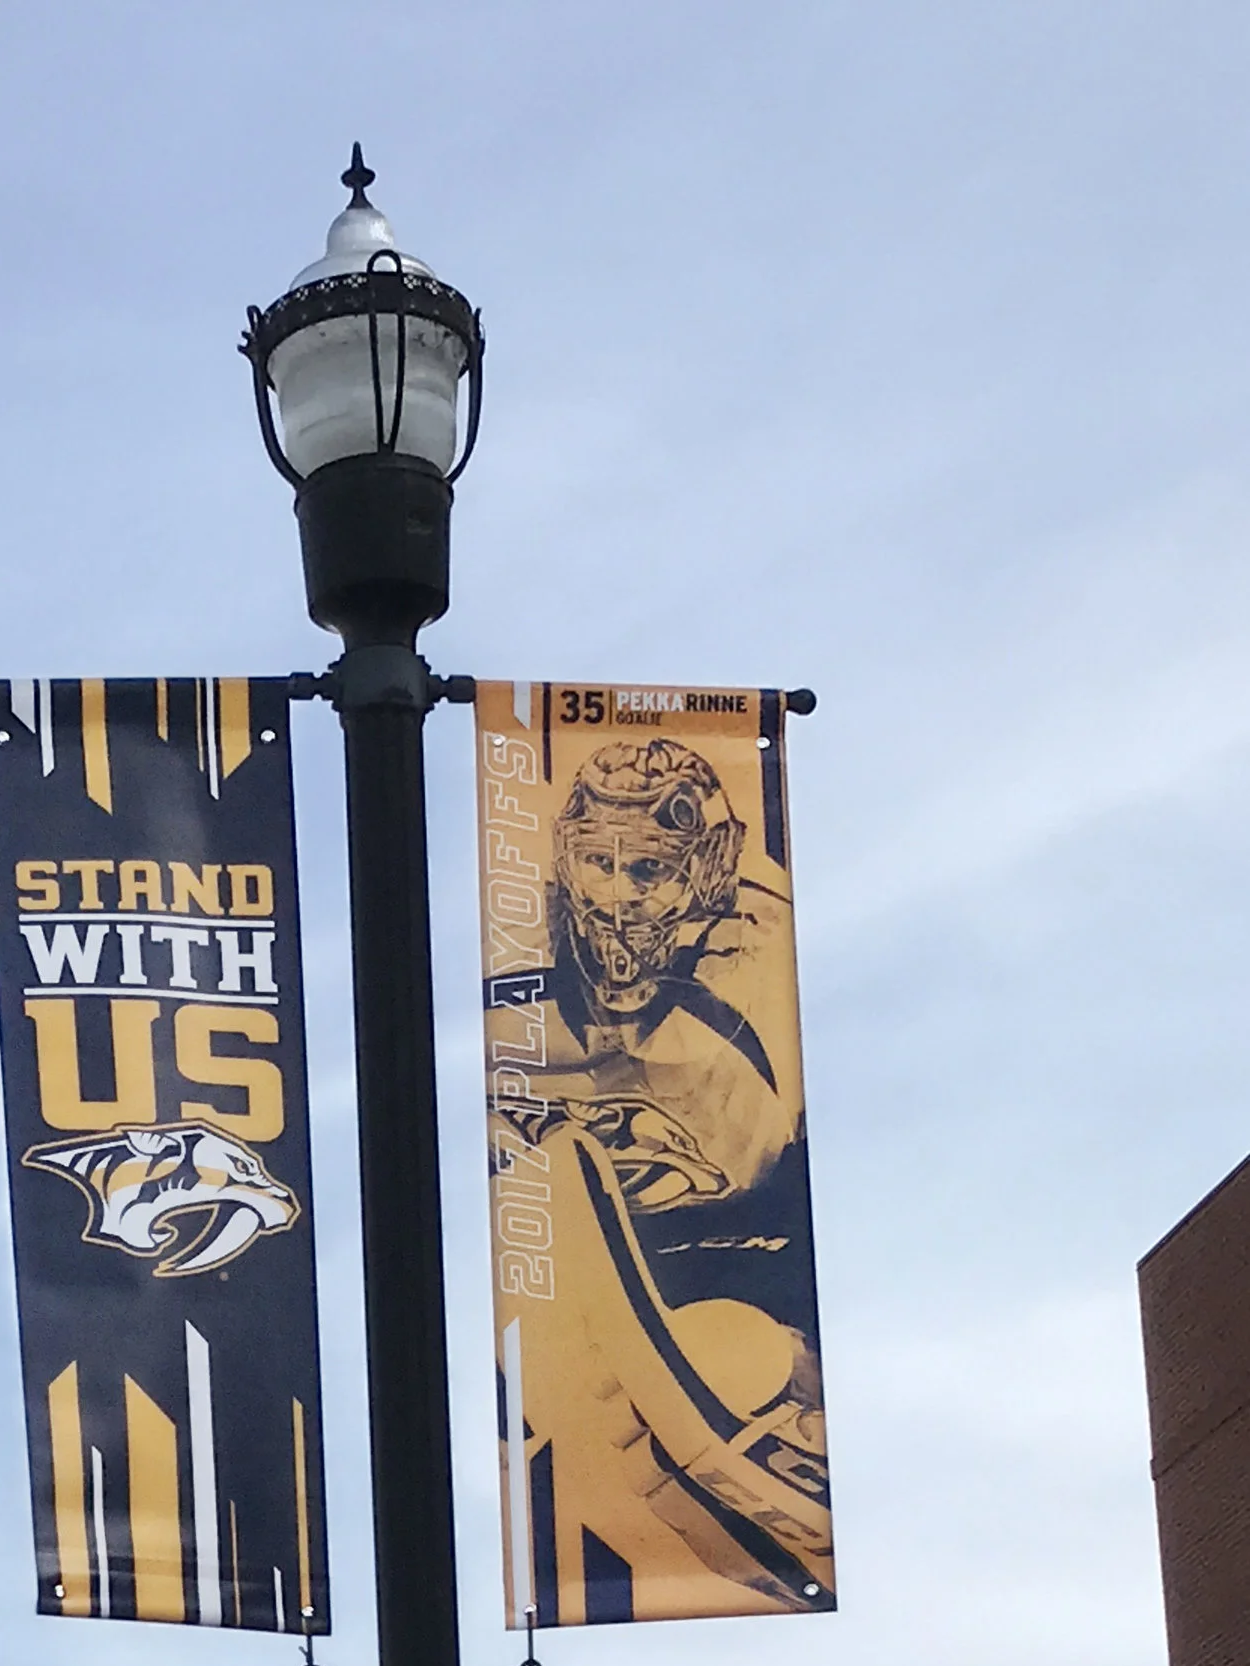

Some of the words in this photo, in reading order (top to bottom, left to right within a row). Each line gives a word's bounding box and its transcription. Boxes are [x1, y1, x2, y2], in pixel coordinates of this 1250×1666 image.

[560, 689, 605, 724] 35
[15, 860, 275, 916] STAND
[483, 730, 549, 1116] PLAYOFFS
[19, 924, 279, 993] WITH
[24, 998, 285, 1142] US
[495, 1129, 555, 1300] 2017
